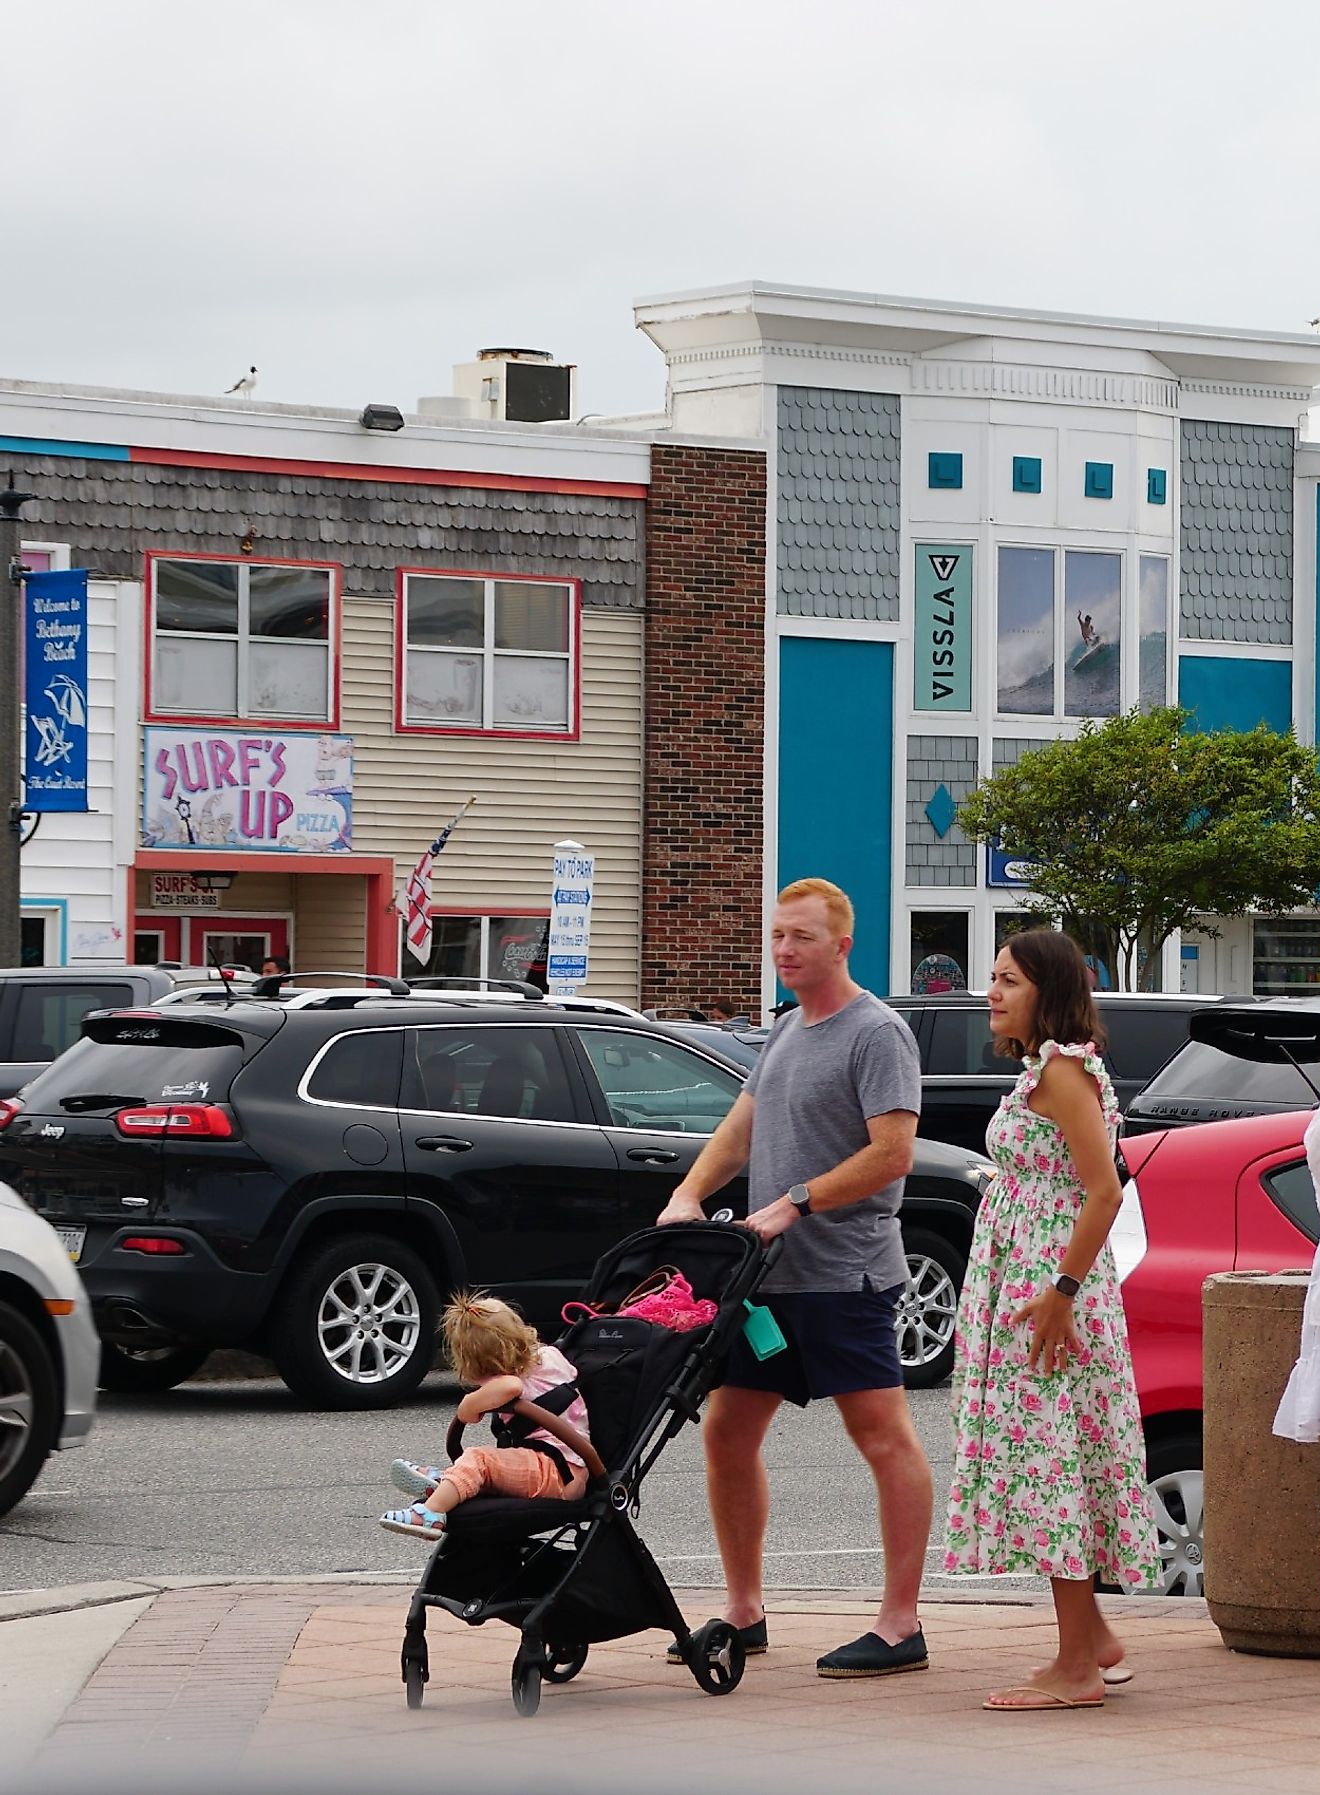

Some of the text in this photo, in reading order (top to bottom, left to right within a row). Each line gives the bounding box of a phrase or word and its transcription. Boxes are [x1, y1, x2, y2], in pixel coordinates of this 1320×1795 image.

[35, 618, 81, 643] Bethany
[932, 586, 956, 702] VISSLA
[156, 739, 287, 800] SURF'S
[240, 789, 294, 839] UP
[296, 813, 340, 832] PIZZA
[155, 876, 198, 893] SURF'S
[1150, 1105, 1266, 1118] RANGE ROVE
[41, 1123, 65, 1139] Jeep
